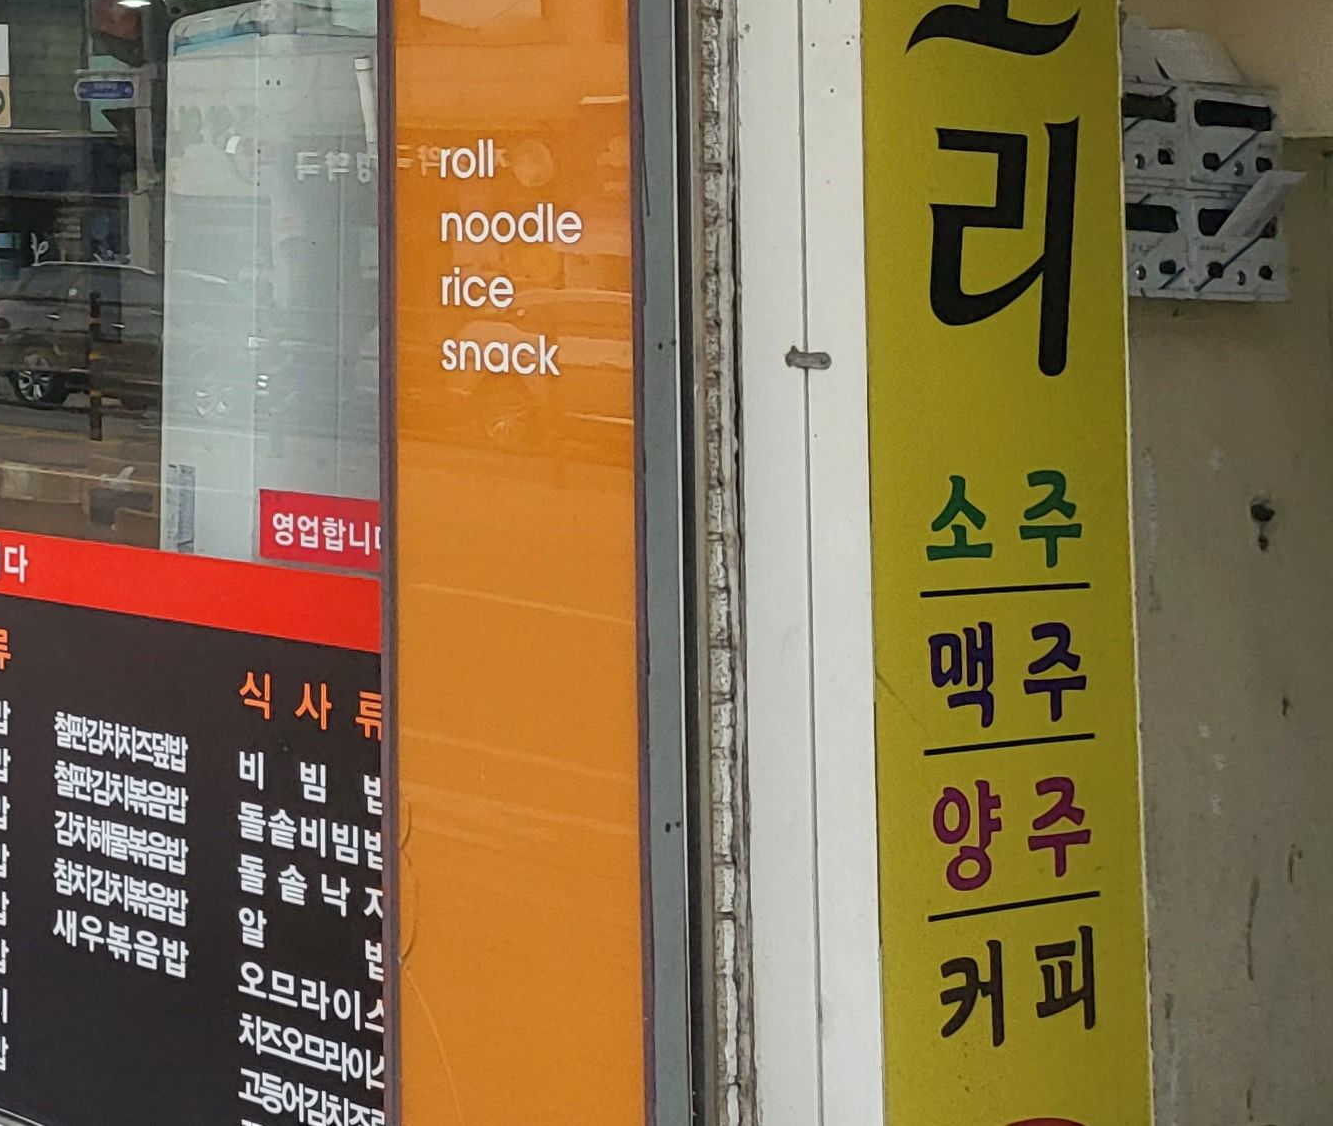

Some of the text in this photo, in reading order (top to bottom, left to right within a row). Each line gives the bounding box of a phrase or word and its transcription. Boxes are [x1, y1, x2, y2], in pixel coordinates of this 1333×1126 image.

[439, 139, 495, 178] roll
[439, 203, 583, 244] noodle
[440, 267, 515, 308] rice
[441, 335, 560, 376] snack
[925, 469, 1083, 569] 소주
[927, 619, 1088, 729] 맥주
[53, 710, 189, 774] 철판김치치즈덮밥
[53, 760, 189, 825] 철판김치볶음밥
[53, 809, 189, 876] 김치해물볶음밥
[932, 775, 1093, 892] 양주
[53, 857, 189, 928] 참치김치볶음밥
[53, 907, 190, 979] 새우볶음밥
[940, 924, 1098, 1049] 커피
